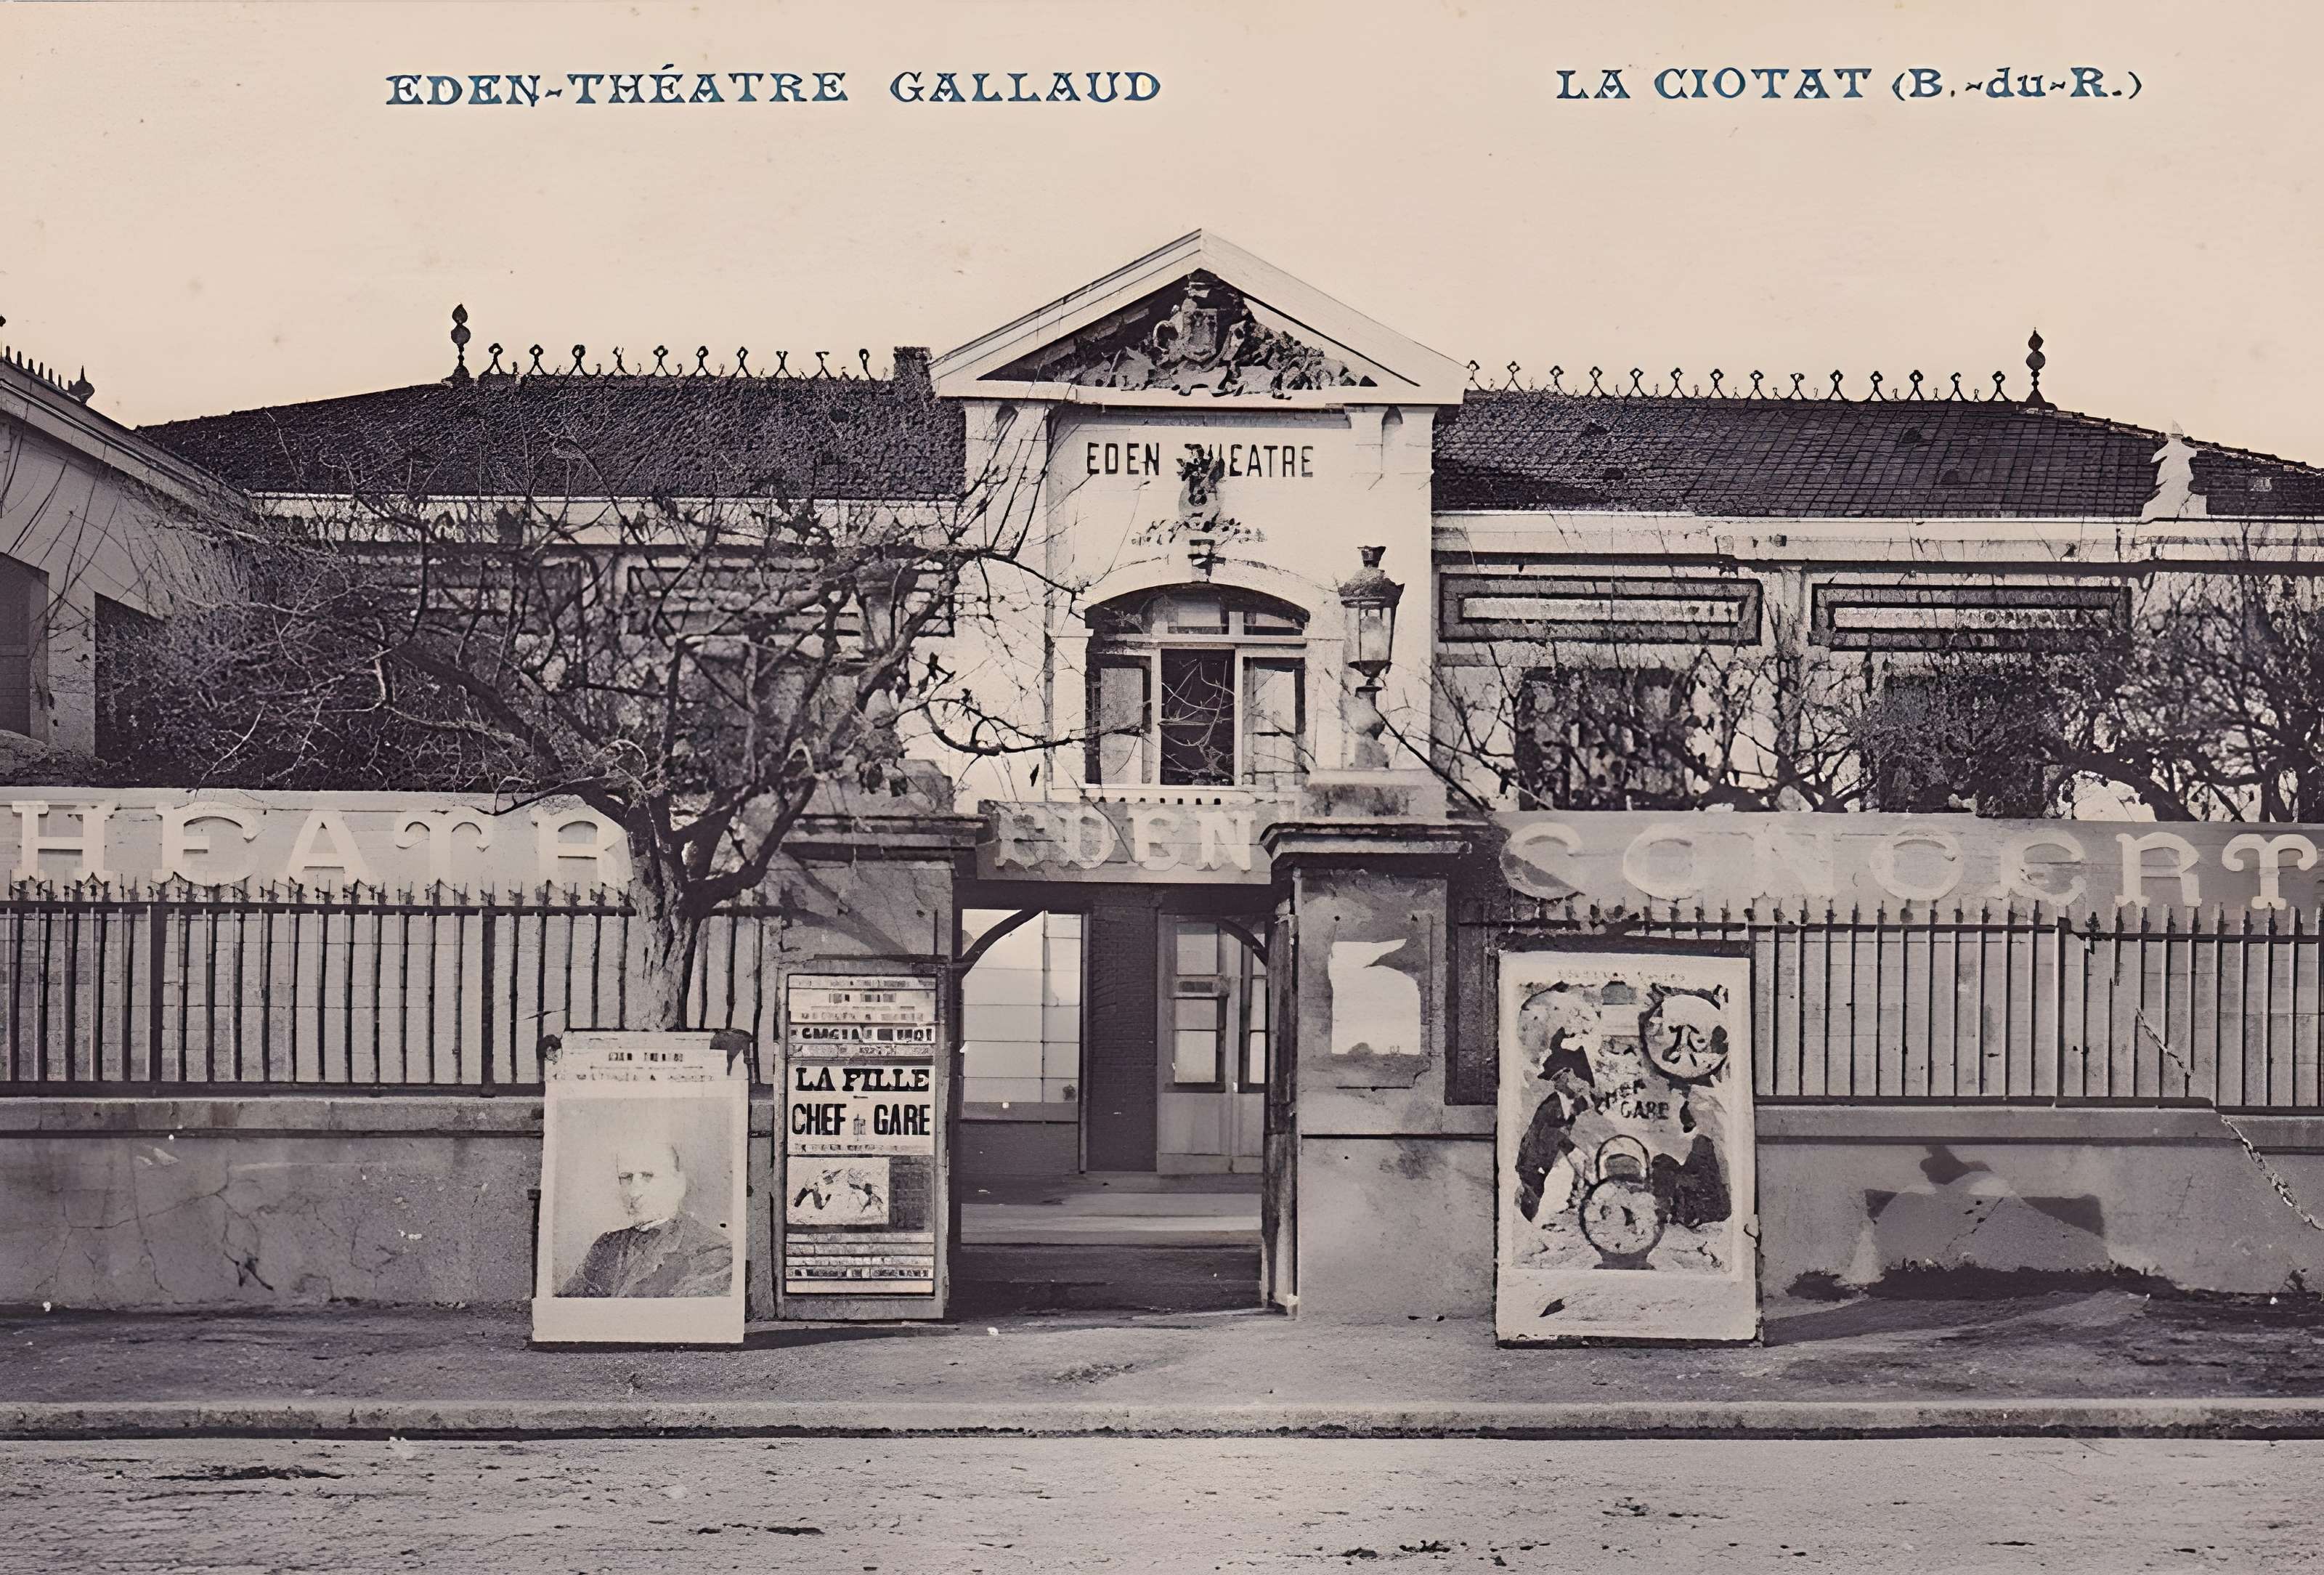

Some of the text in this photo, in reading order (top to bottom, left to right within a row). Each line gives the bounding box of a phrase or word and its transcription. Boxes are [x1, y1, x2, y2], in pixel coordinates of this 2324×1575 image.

[1086, 442, 1160, 477] EDEN
[796, 1066, 837, 1092] LA
[792, 1103, 847, 1135] CHEF
[874, 1104, 930, 1135] GARE
